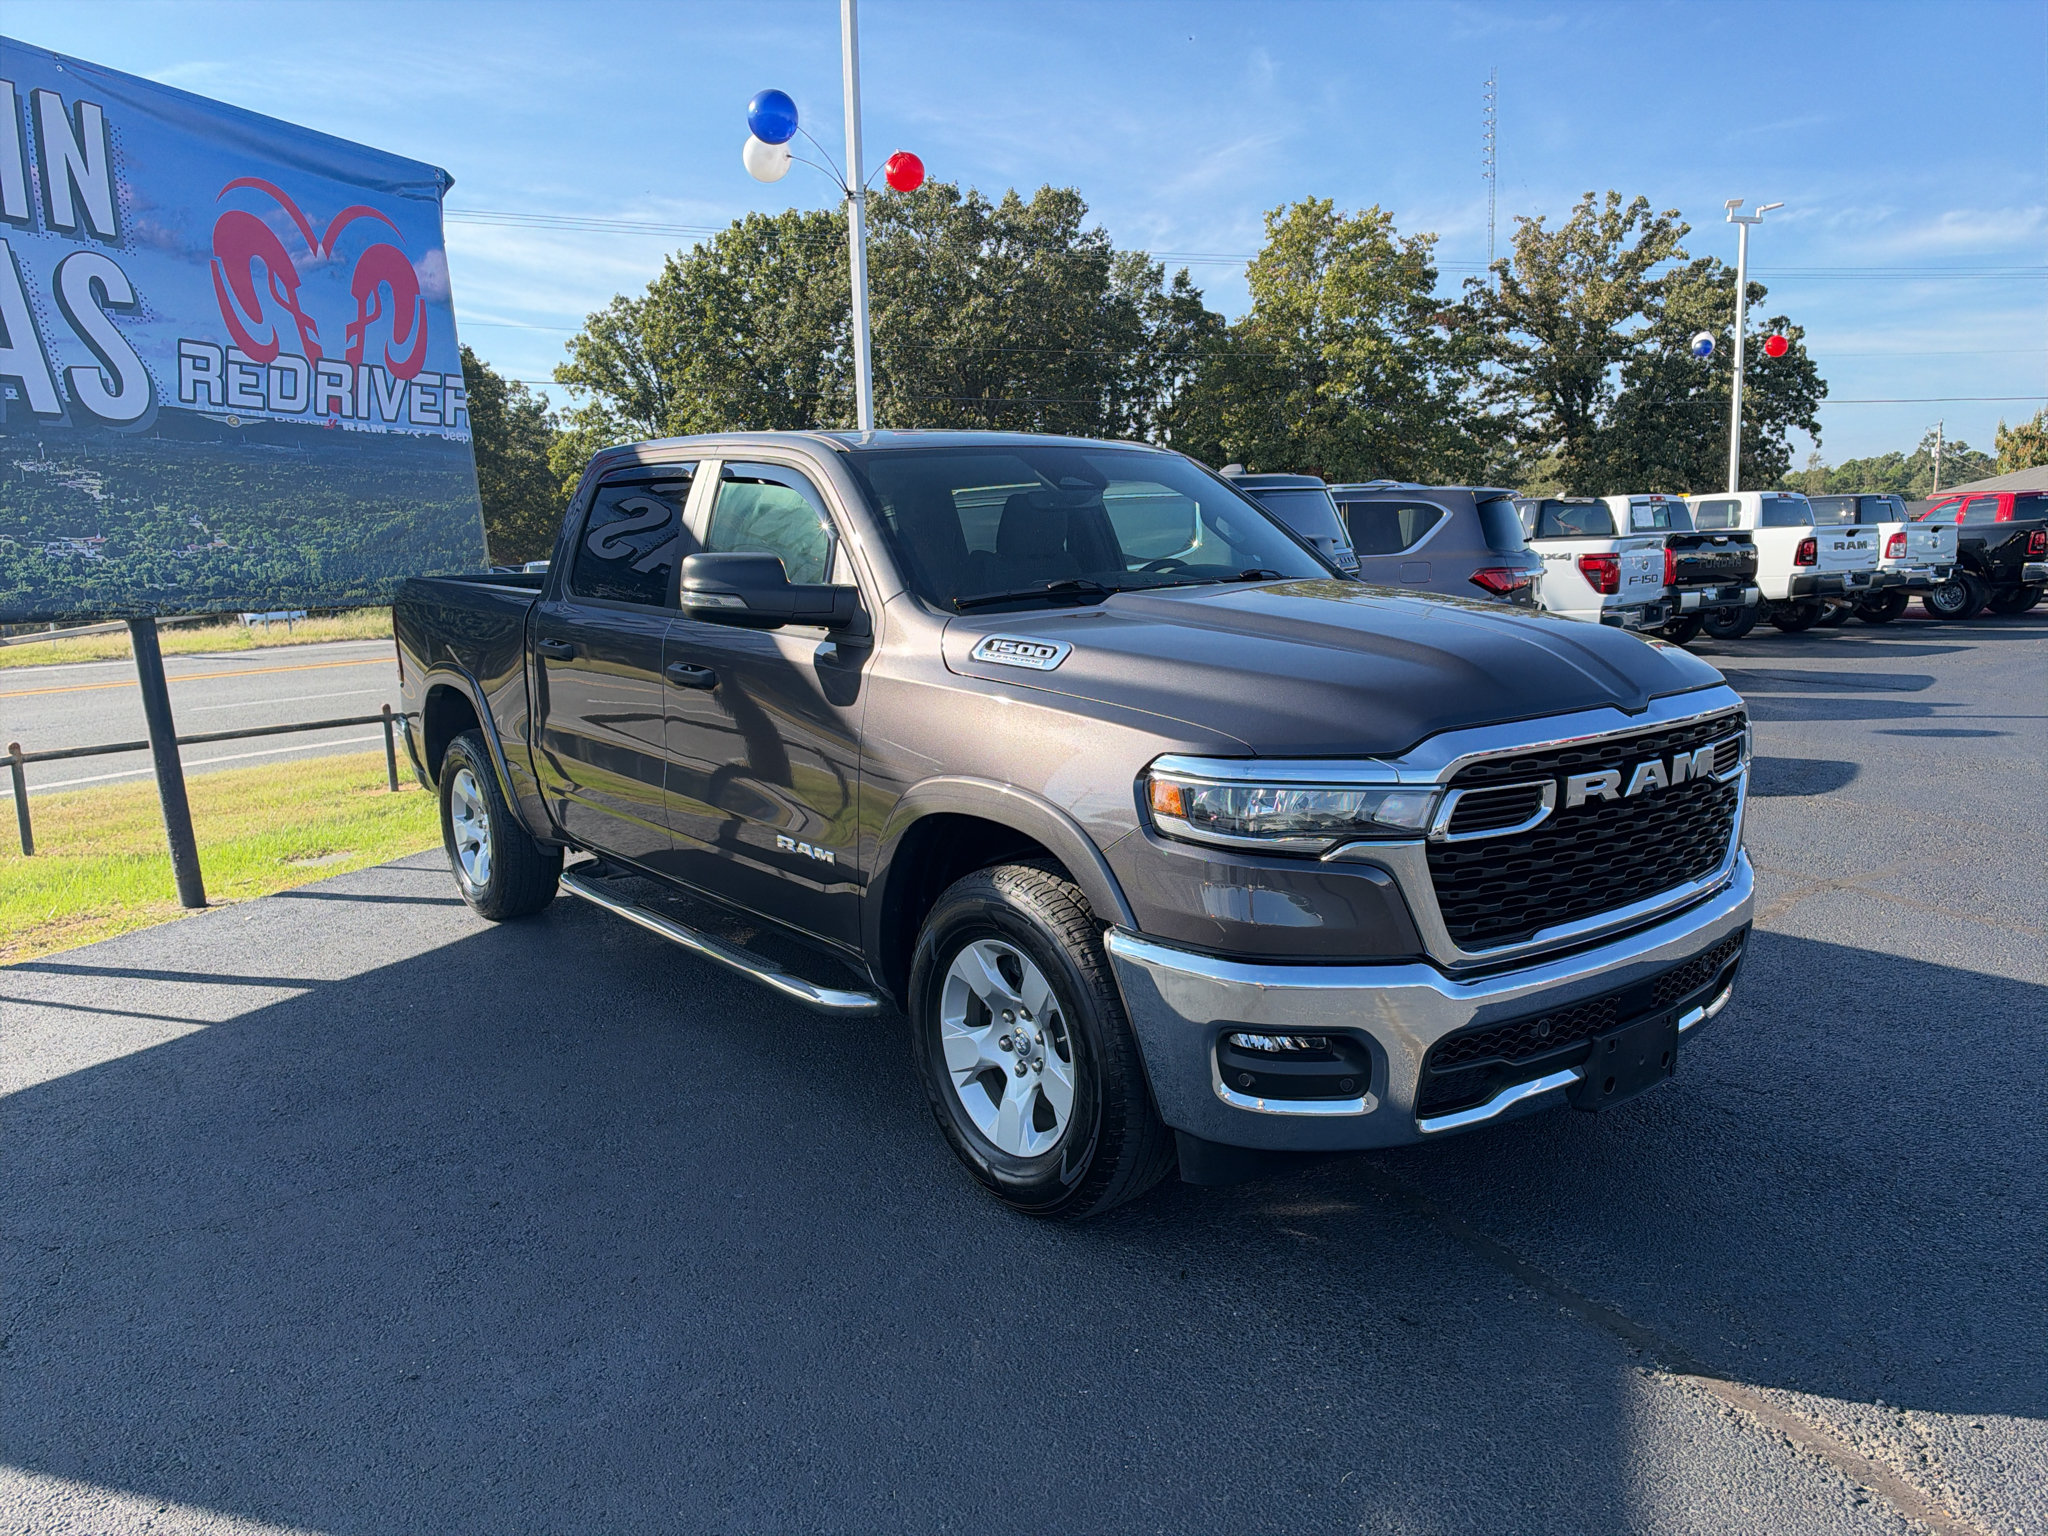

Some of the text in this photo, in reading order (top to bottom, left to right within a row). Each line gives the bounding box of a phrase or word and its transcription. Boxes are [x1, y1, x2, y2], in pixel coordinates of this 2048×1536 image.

[342, 421, 388, 434] RAM
[441, 428, 470, 445] Jeep
[1834, 541, 1868, 551] RAM
[1629, 574, 1659, 586] F-150
[991, 639, 1056, 660] 1500
[1566, 744, 1715, 809] RAM
[776, 834, 836, 867] RAM
